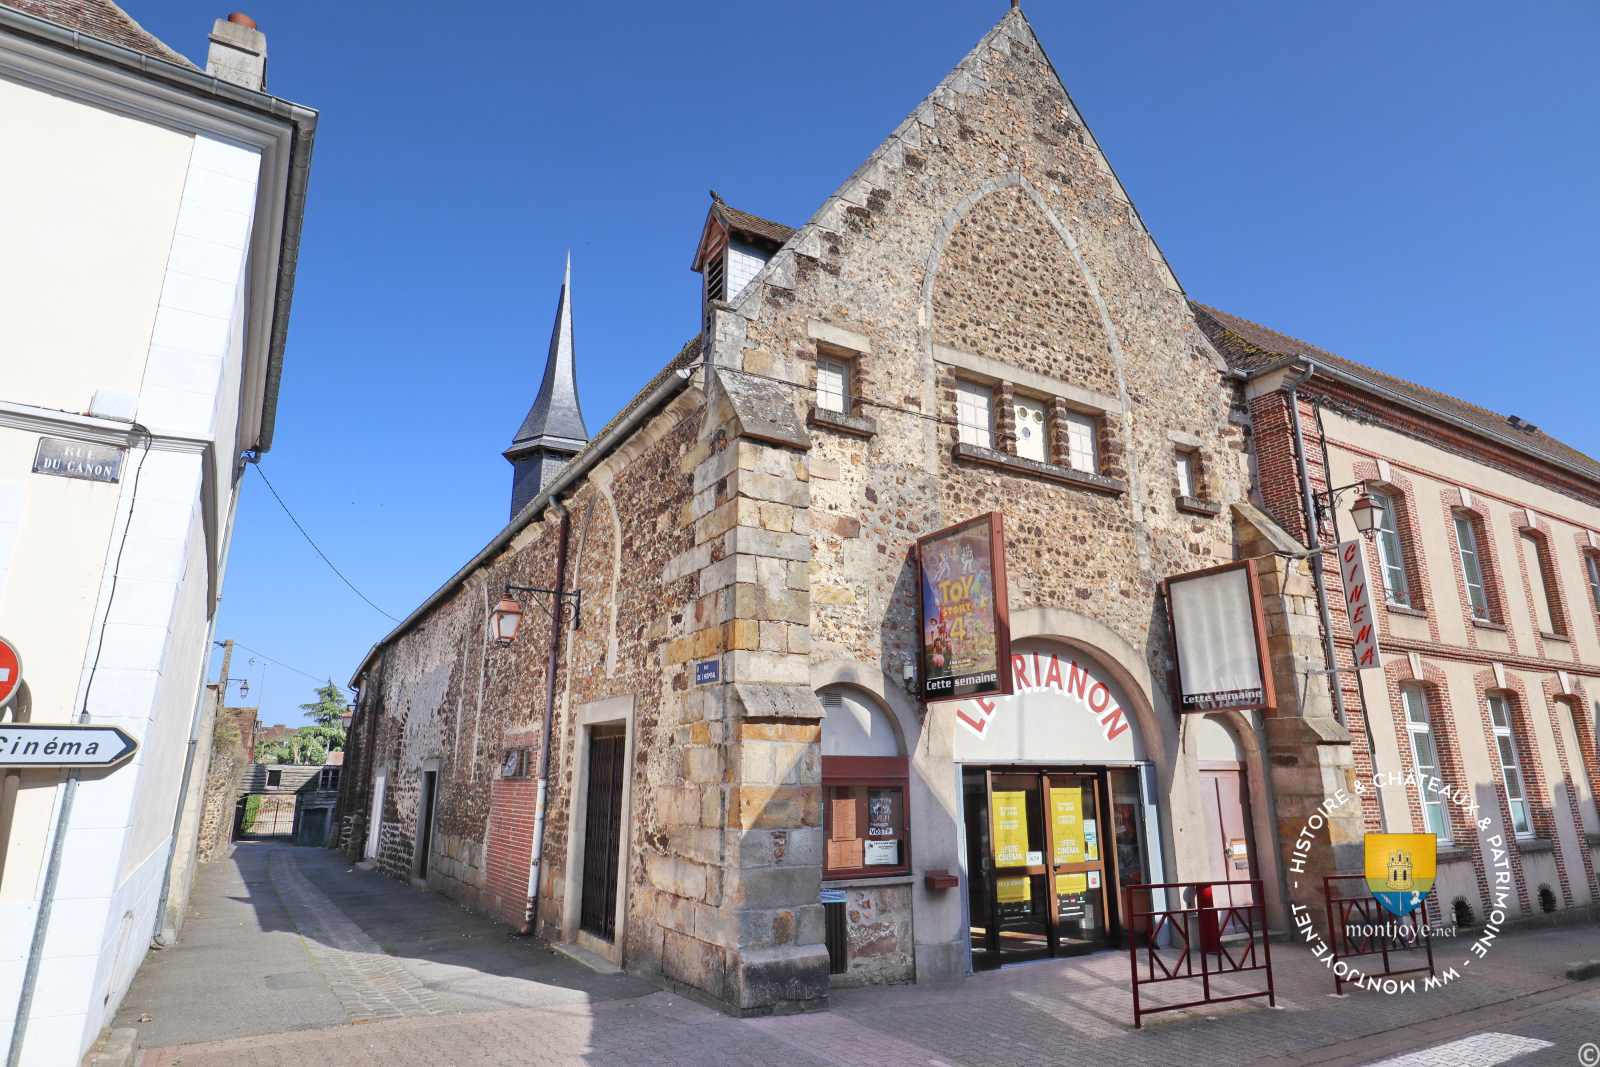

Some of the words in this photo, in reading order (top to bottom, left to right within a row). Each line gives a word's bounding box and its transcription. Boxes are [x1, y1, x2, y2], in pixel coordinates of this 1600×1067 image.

[64, 447, 96, 460] RUE
[43, 457, 61, 469] DU
[67, 460, 113, 477] CANON
[938, 575, 974, 602] TOY
[942, 602, 974, 617] STORY
[1343, 543, 1374, 666] CINEMA
[950, 617, 966, 641] 4
[926, 678, 951, 691] Cette
[954, 672, 997, 687] semaine
[1011, 652, 1129, 741] RIANON
[1183, 694, 1212, 704] Cette
[1215, 690, 1262, 701] semaine
